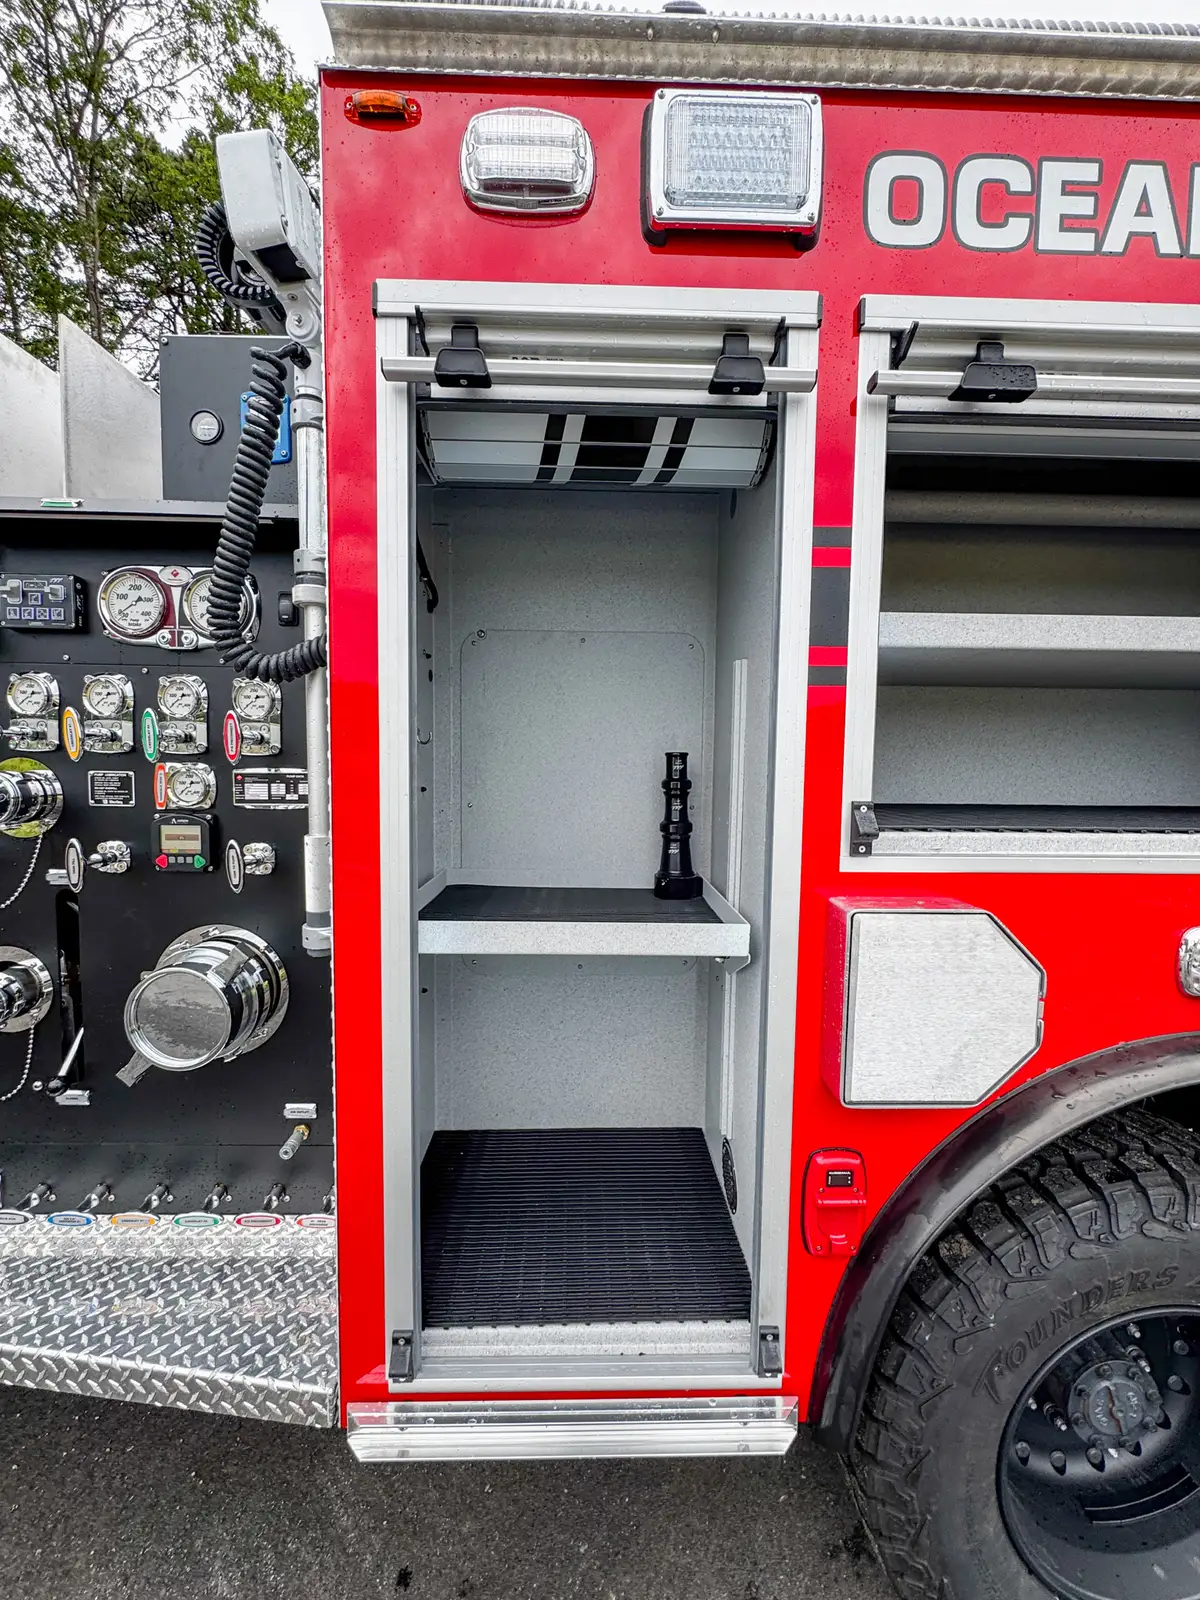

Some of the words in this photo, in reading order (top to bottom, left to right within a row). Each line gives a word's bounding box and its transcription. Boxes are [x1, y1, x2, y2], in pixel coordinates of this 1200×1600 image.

[863, 150, 1200, 259] OCEA
[128, 583, 142, 591] 200
[116, 593, 128, 601] 100
